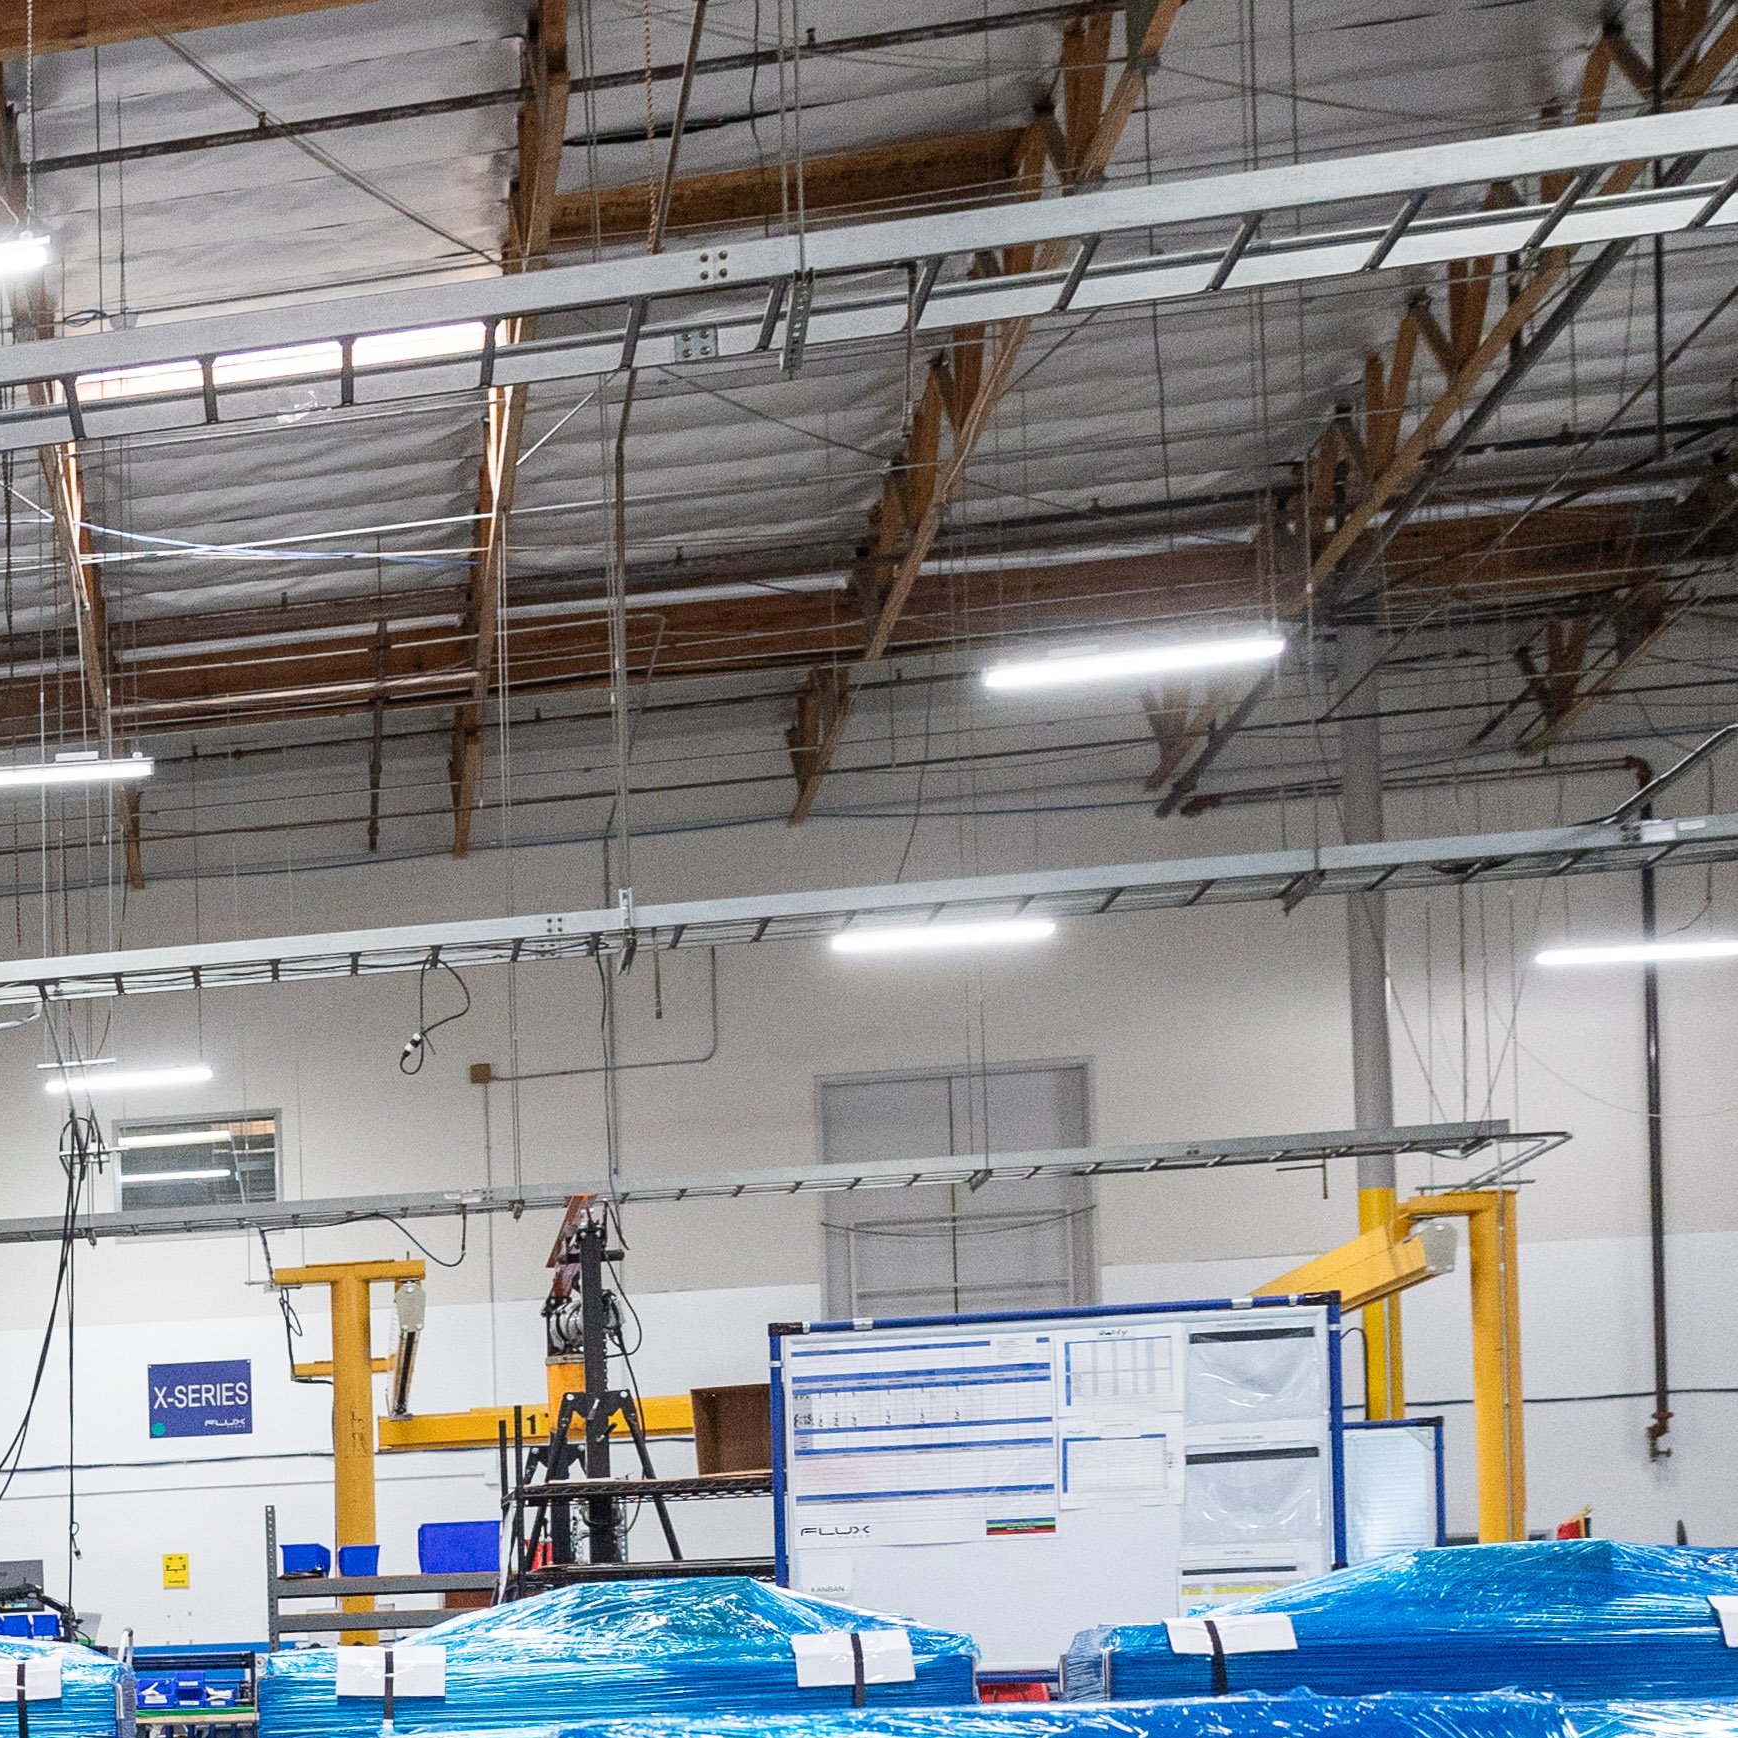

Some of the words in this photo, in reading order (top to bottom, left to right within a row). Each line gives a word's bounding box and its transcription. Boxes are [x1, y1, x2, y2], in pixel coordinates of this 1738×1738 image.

[153, 1382, 250, 1410] X-SERIES
[204, 1418, 246, 1427] FLUX
[526, 1414, 537, 1435] 1
[801, 1525, 870, 1537] FLUX
